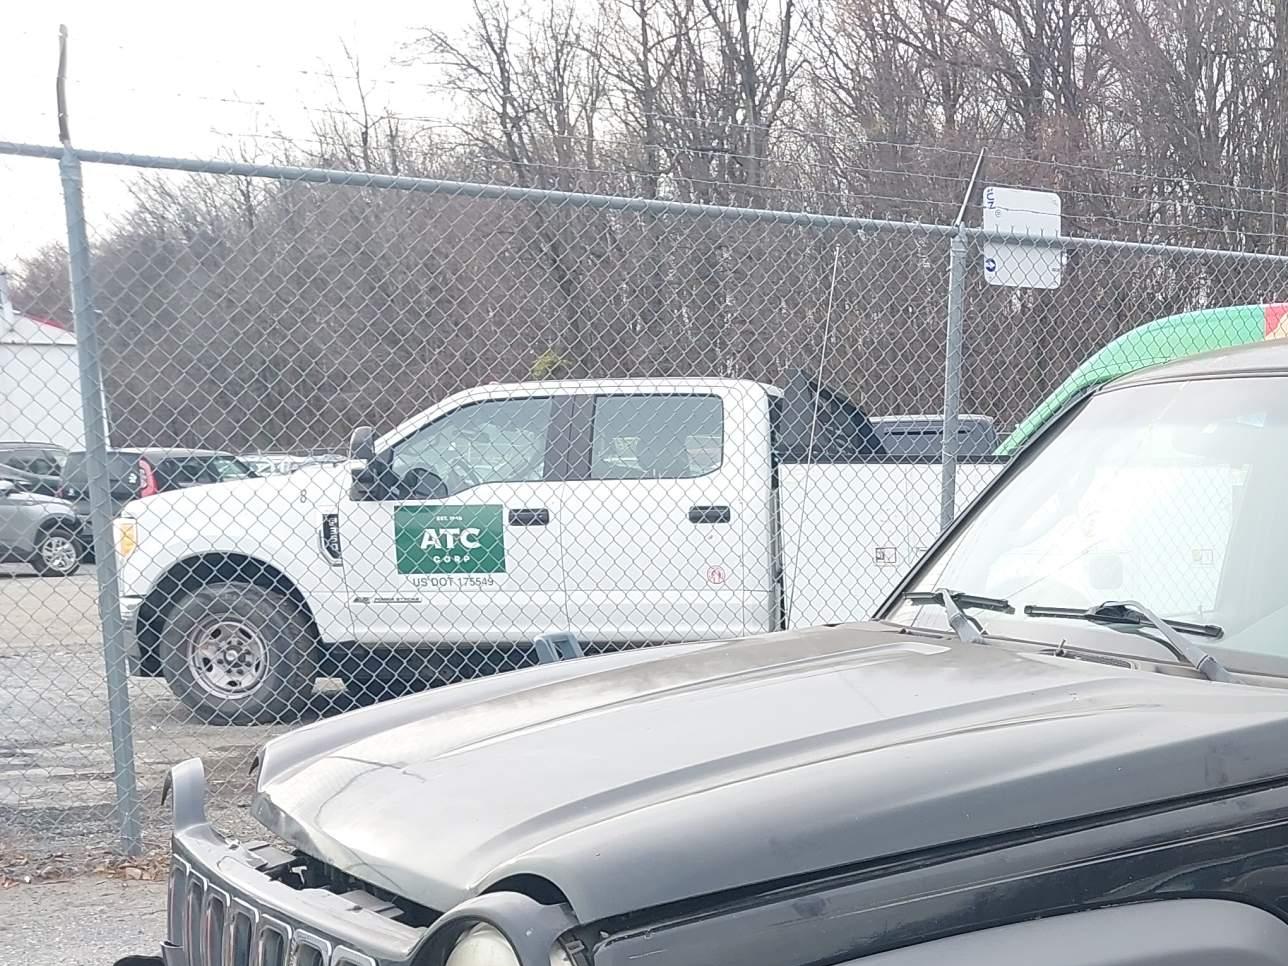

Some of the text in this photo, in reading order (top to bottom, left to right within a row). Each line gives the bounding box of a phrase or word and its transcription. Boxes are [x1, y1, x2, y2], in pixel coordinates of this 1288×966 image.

[299, 488, 307, 504] 8
[420, 527, 481, 549] ATC
[433, 555, 471, 563] CORP
[412, 577, 428, 587] US
[431, 577, 454, 587] DOT
